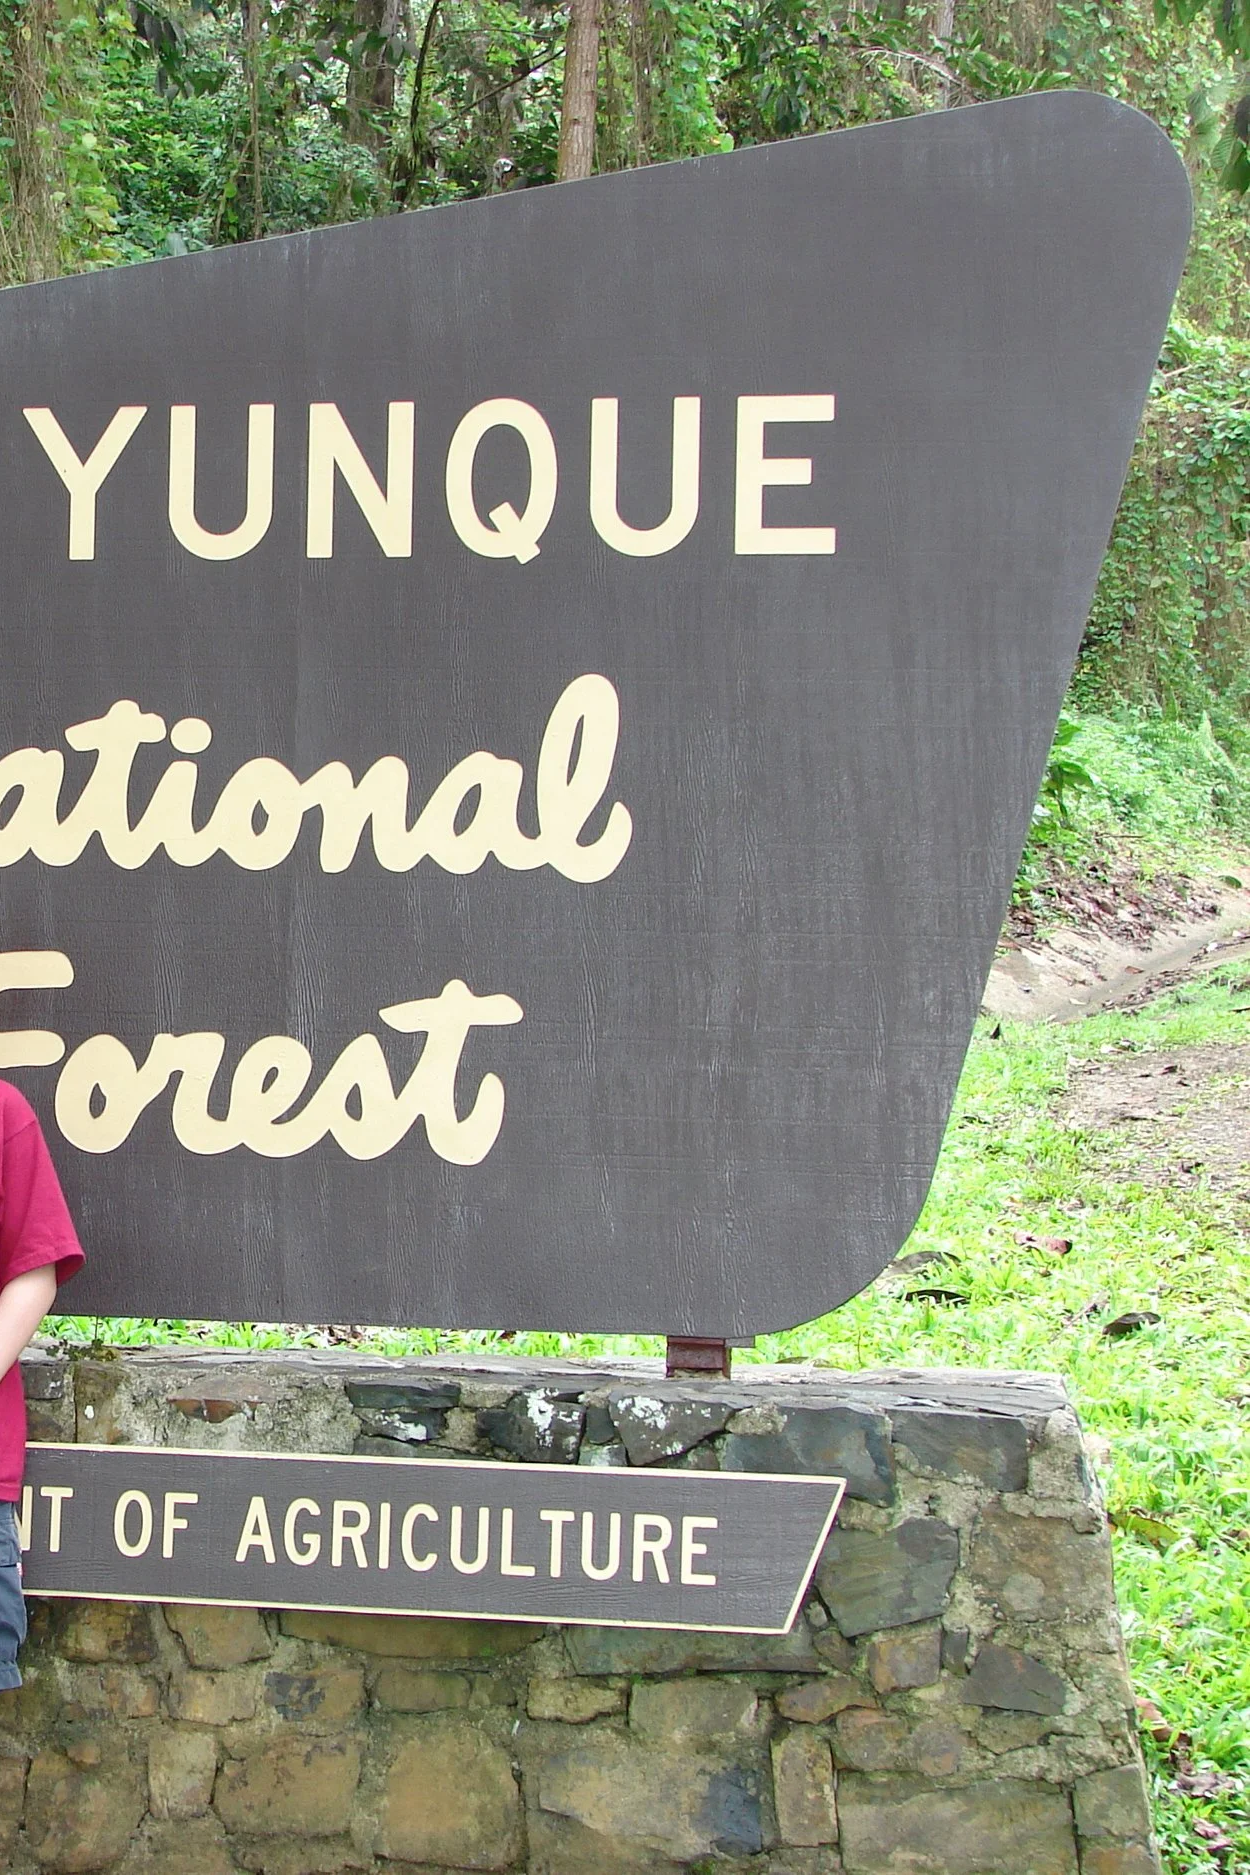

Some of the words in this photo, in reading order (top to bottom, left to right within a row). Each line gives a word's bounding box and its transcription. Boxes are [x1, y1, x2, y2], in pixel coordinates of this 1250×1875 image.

[22, 394, 836, 565] YUNQUE
[113, 1489, 199, 1560] OF
[235, 1495, 719, 1586] AGRICULTURE
